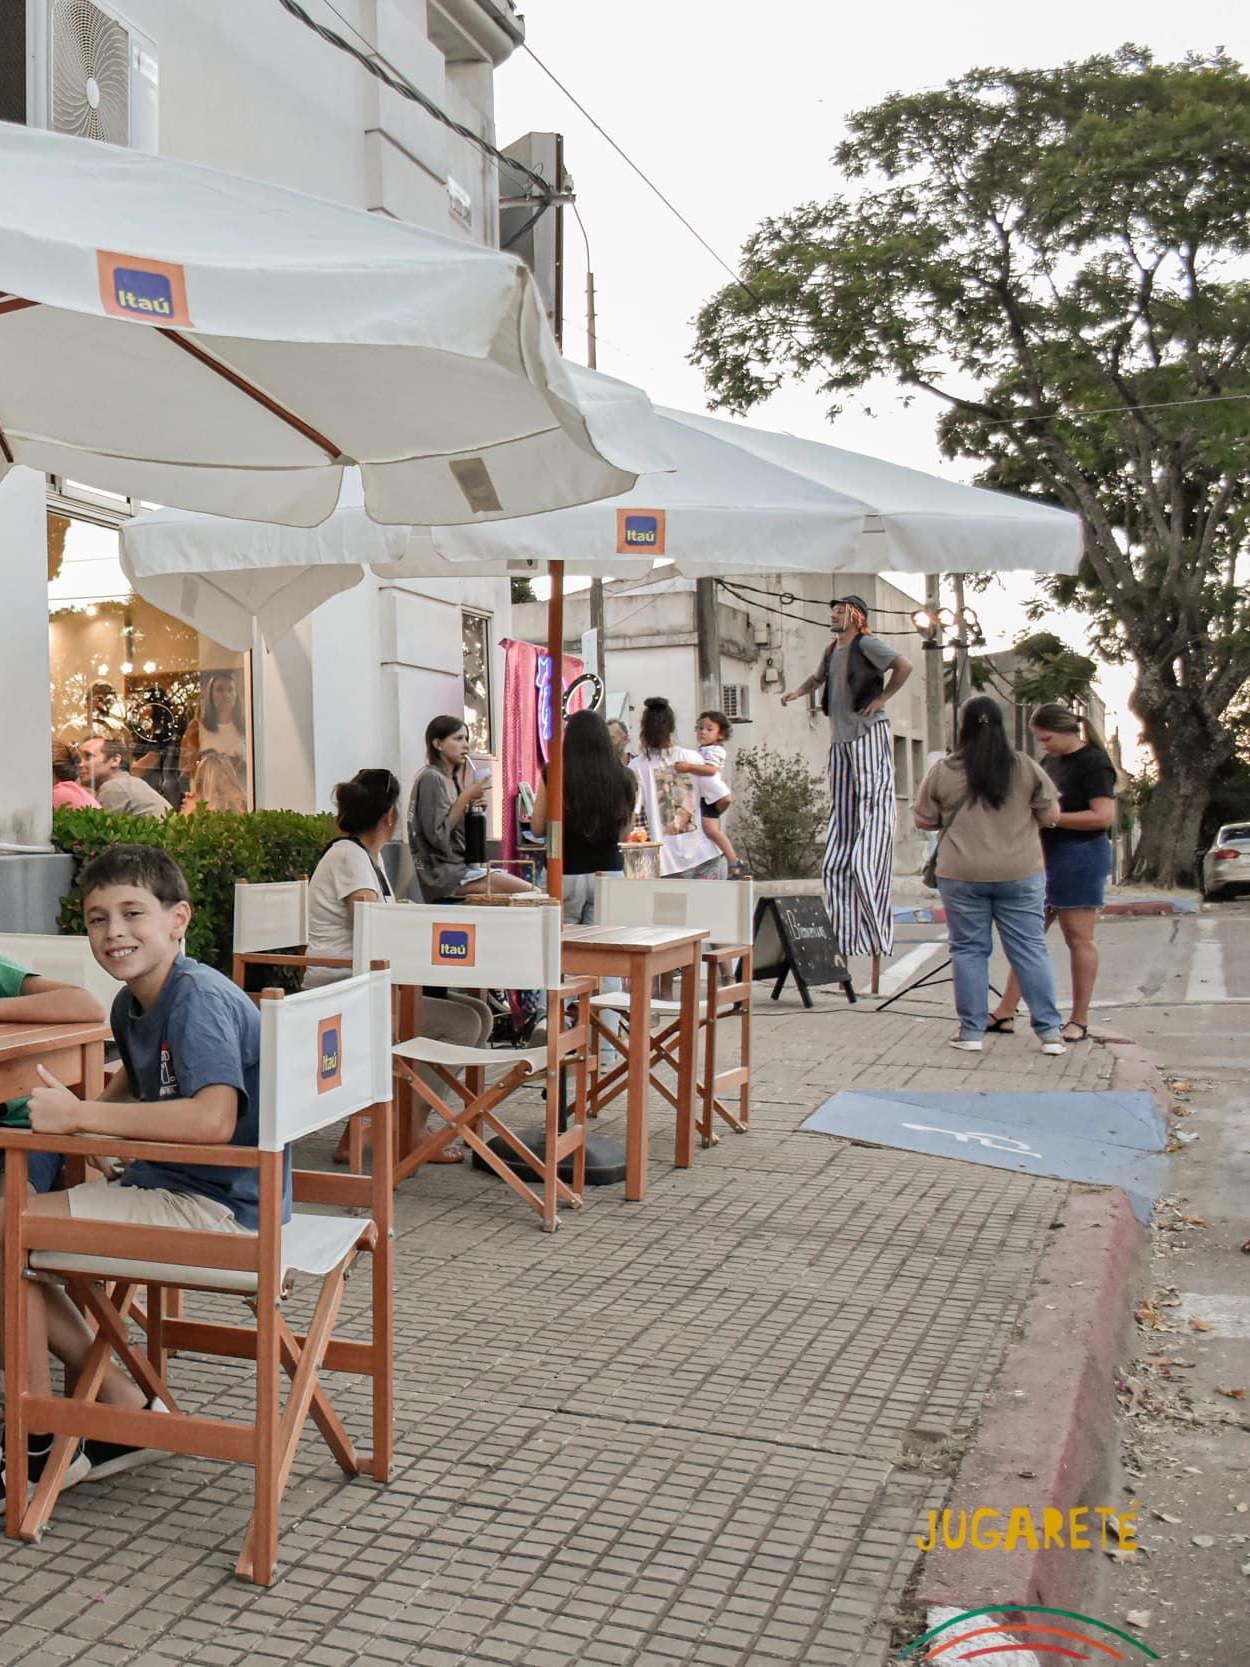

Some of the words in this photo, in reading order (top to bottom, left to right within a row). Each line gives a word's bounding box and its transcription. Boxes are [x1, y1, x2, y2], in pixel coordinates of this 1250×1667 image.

[118, 289, 170, 315] Itaú
[626, 529, 655, 542] Itaú
[440, 943, 466, 955] Itaú
[322, 1051, 338, 1073] Itaú
